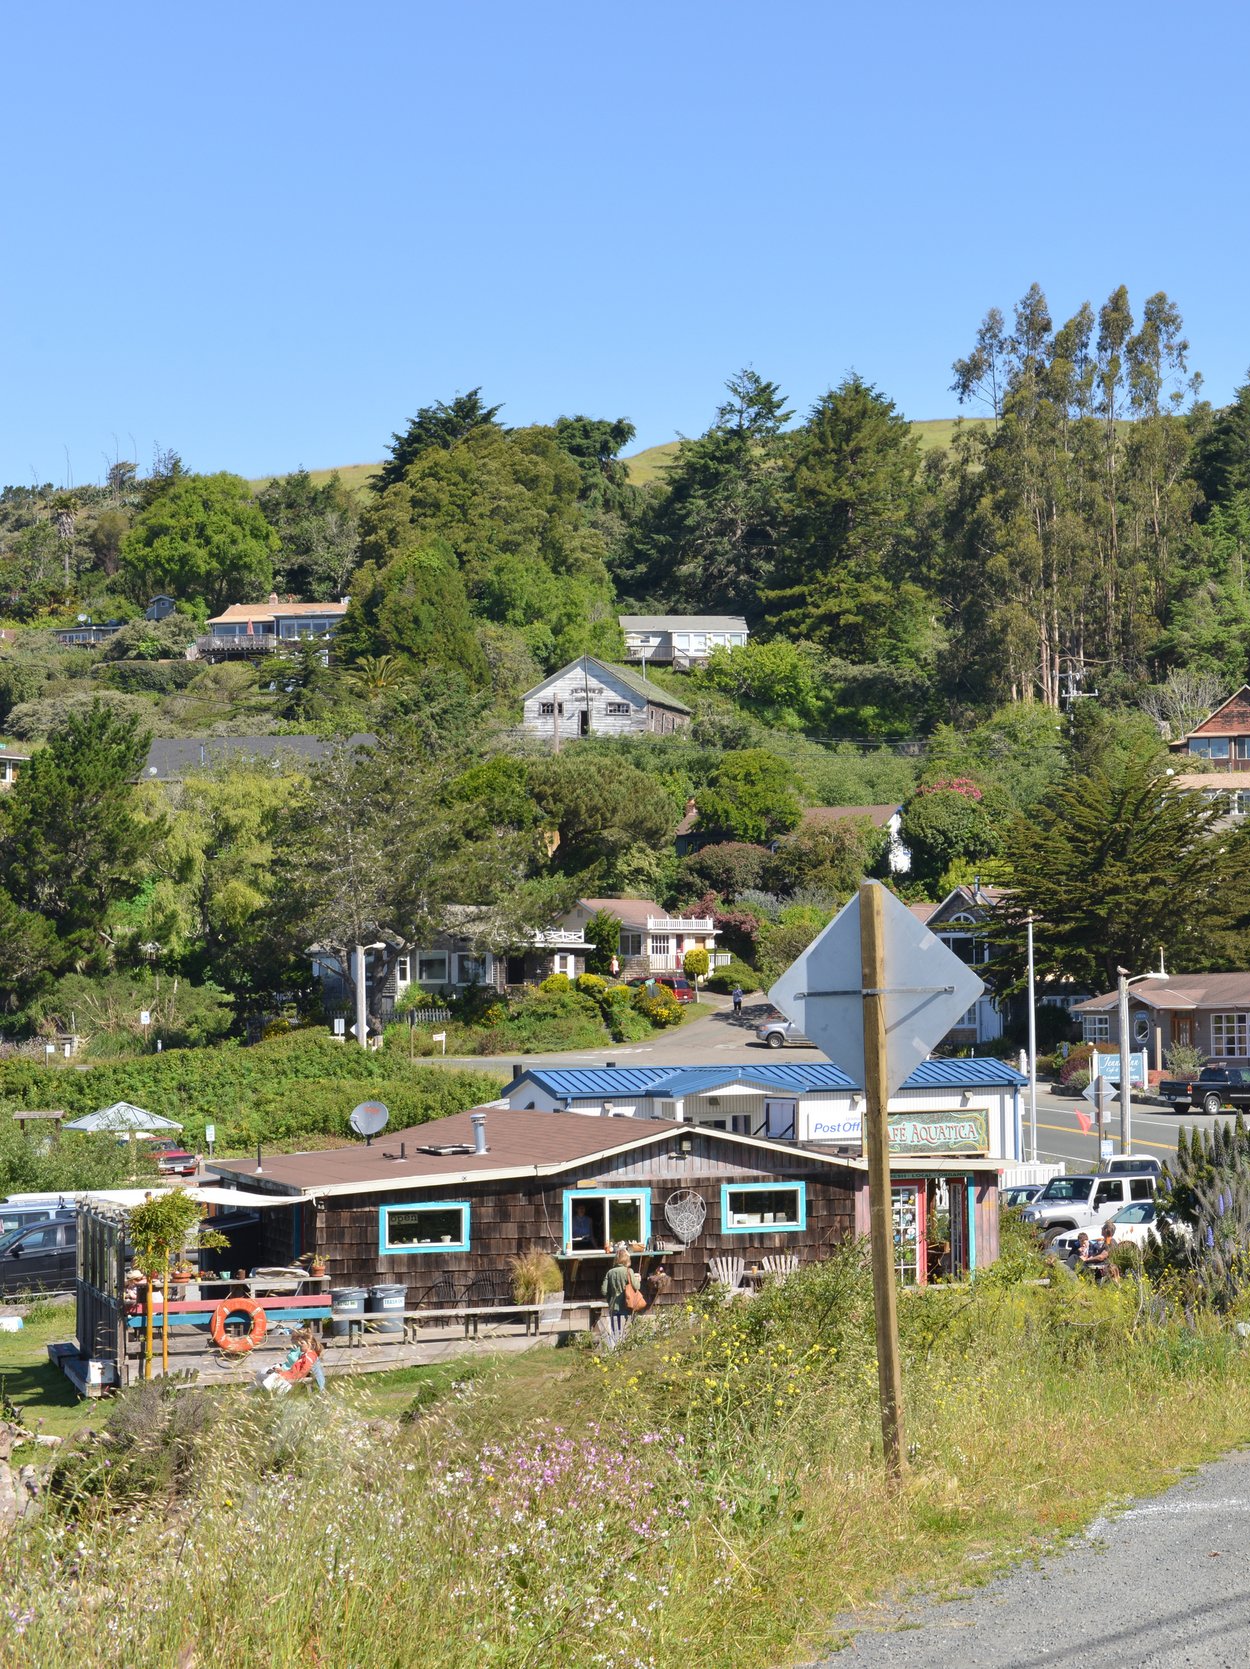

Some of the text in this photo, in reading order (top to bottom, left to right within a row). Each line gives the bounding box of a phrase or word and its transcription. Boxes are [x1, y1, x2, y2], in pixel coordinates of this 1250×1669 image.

[1100, 1056, 1121, 1069] Jenn
[814, 1123, 841, 1133] Post
[887, 1122, 977, 1143] AFÉ AQUATICA
